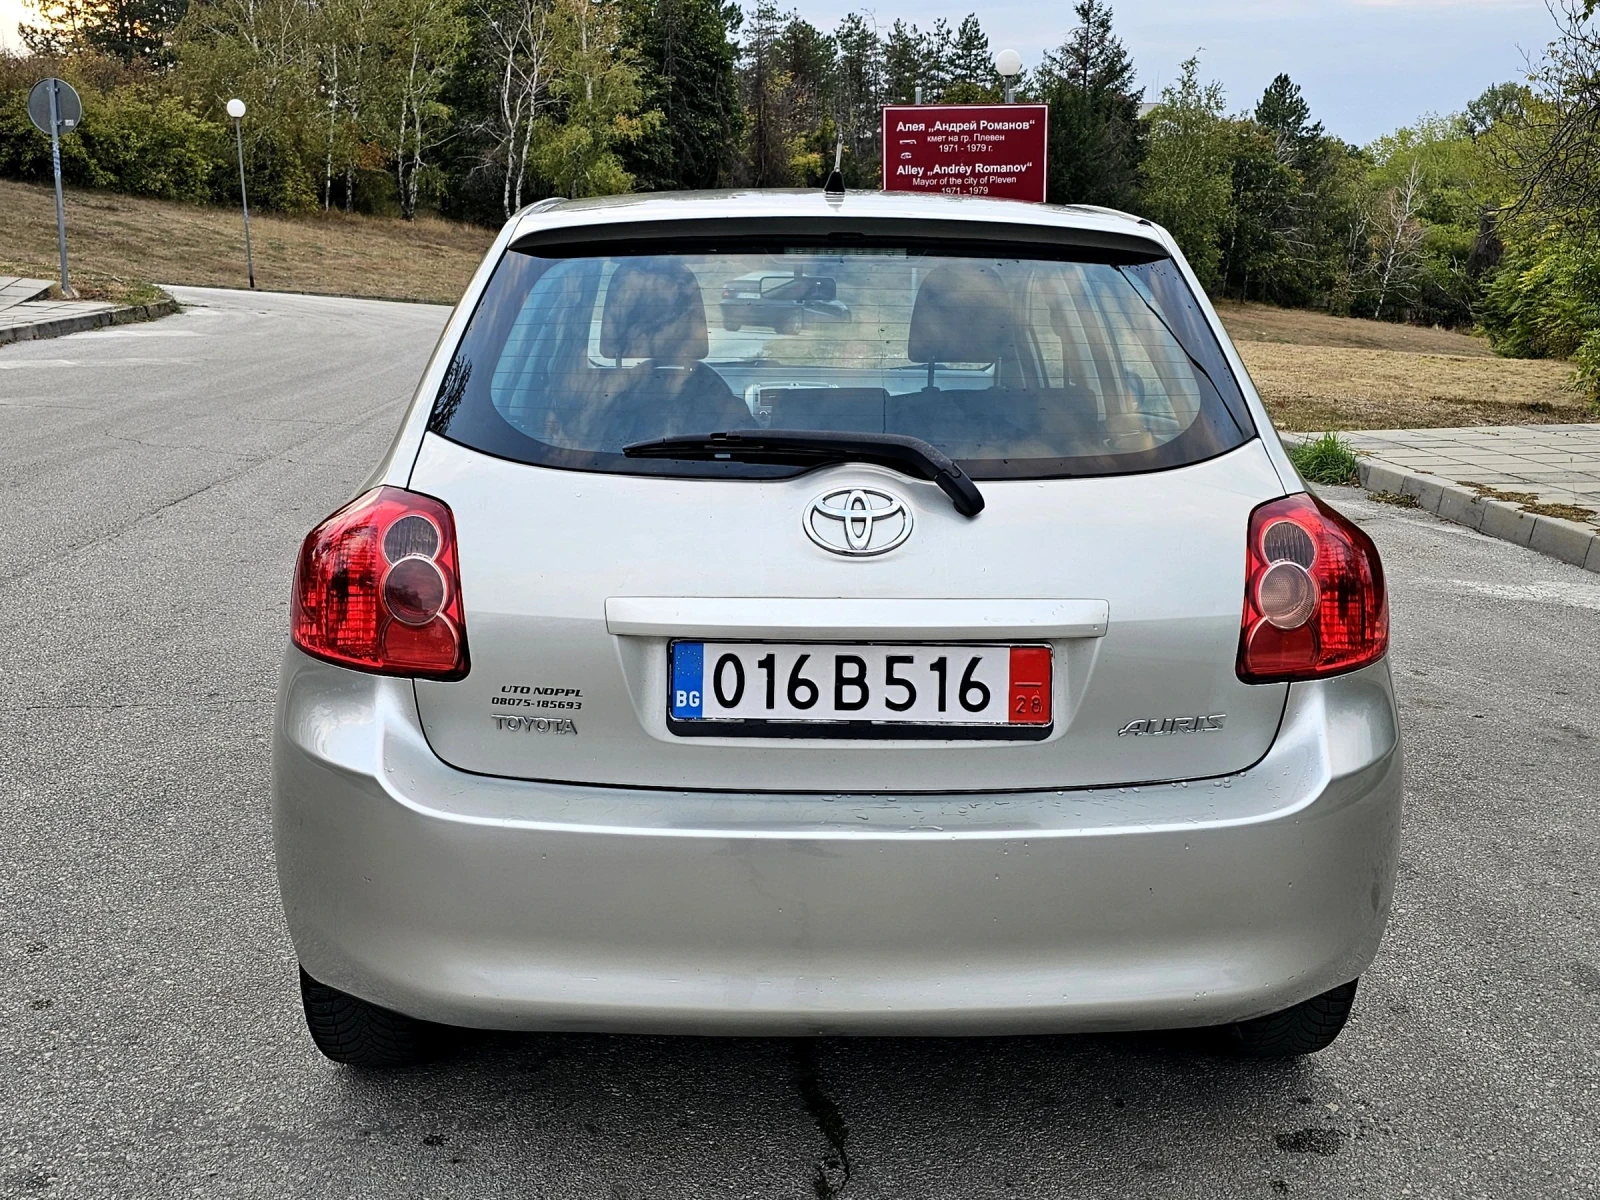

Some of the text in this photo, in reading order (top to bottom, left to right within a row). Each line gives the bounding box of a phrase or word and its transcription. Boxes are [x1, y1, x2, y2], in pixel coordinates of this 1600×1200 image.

[896, 121, 926, 132] Алея
[960, 135, 971, 143] гр.
[973, 133, 1005, 142] Плевен
[939, 144, 958, 153] 1971
[966, 143, 987, 152] 1979
[896, 164, 925, 177] Alley
[912, 175, 1017, 188] Mayor of the city of Pleven
[941, 187, 961, 195] 1971
[969, 186, 989, 195] 1979
[676, 690, 700, 708] BG
[713, 652, 991, 713] 016B516
[501, 685, 583, 698] UTO NOPPL
[491, 697, 582, 710] 08075-185693
[491, 713, 578, 735] TOYOTA
[1118, 714, 1227, 736] AURIS
